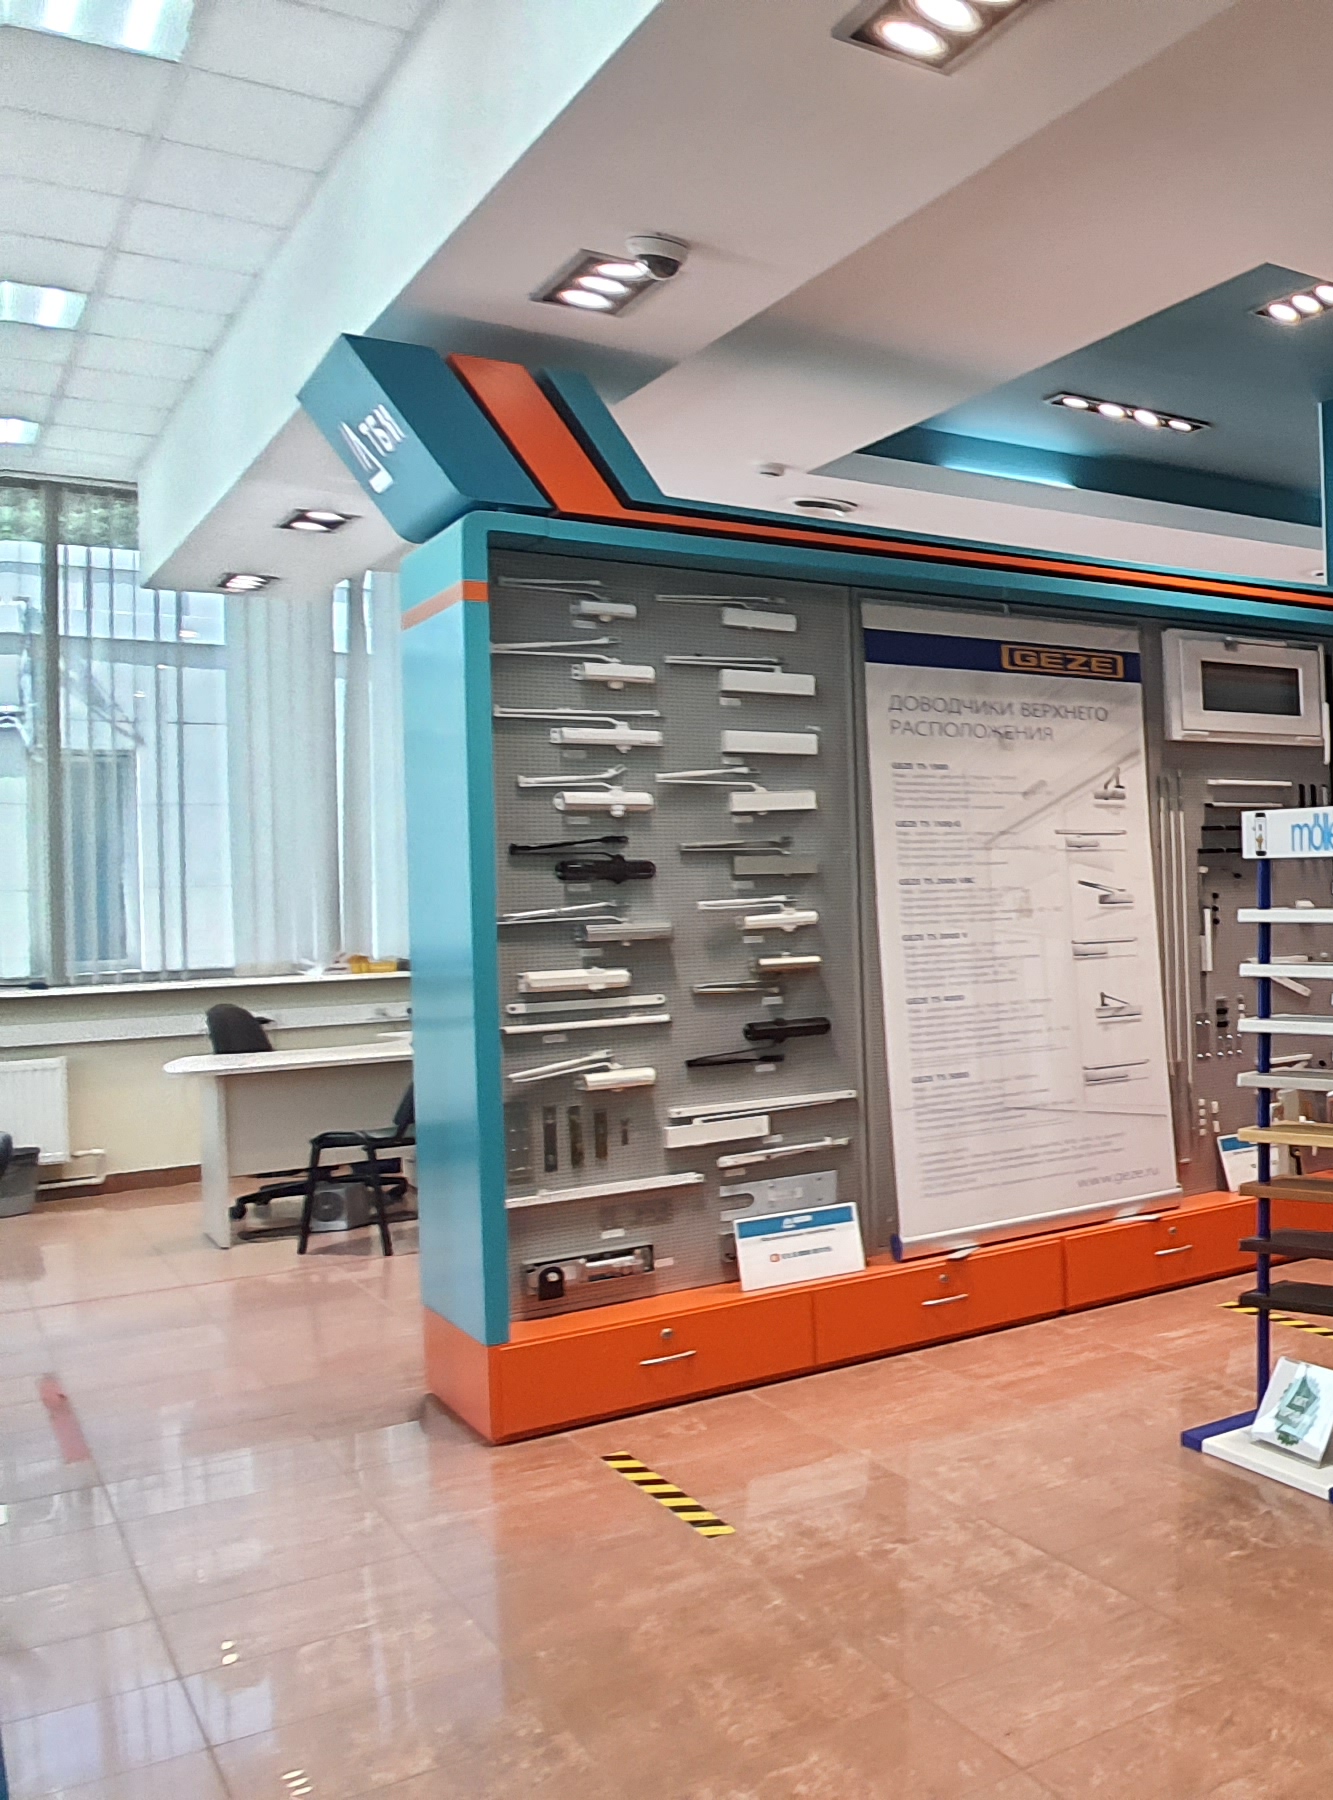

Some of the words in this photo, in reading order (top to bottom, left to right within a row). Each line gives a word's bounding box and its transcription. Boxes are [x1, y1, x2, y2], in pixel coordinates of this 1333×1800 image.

[1014, 650, 1114, 673] GEZE
[889, 695, 1014, 716] ДОВОДЧИКИ
[1021, 703, 1108, 721] ВЕРХНЕГО
[890, 720, 1054, 740] РАСПОЛОЖЕНИЯ
